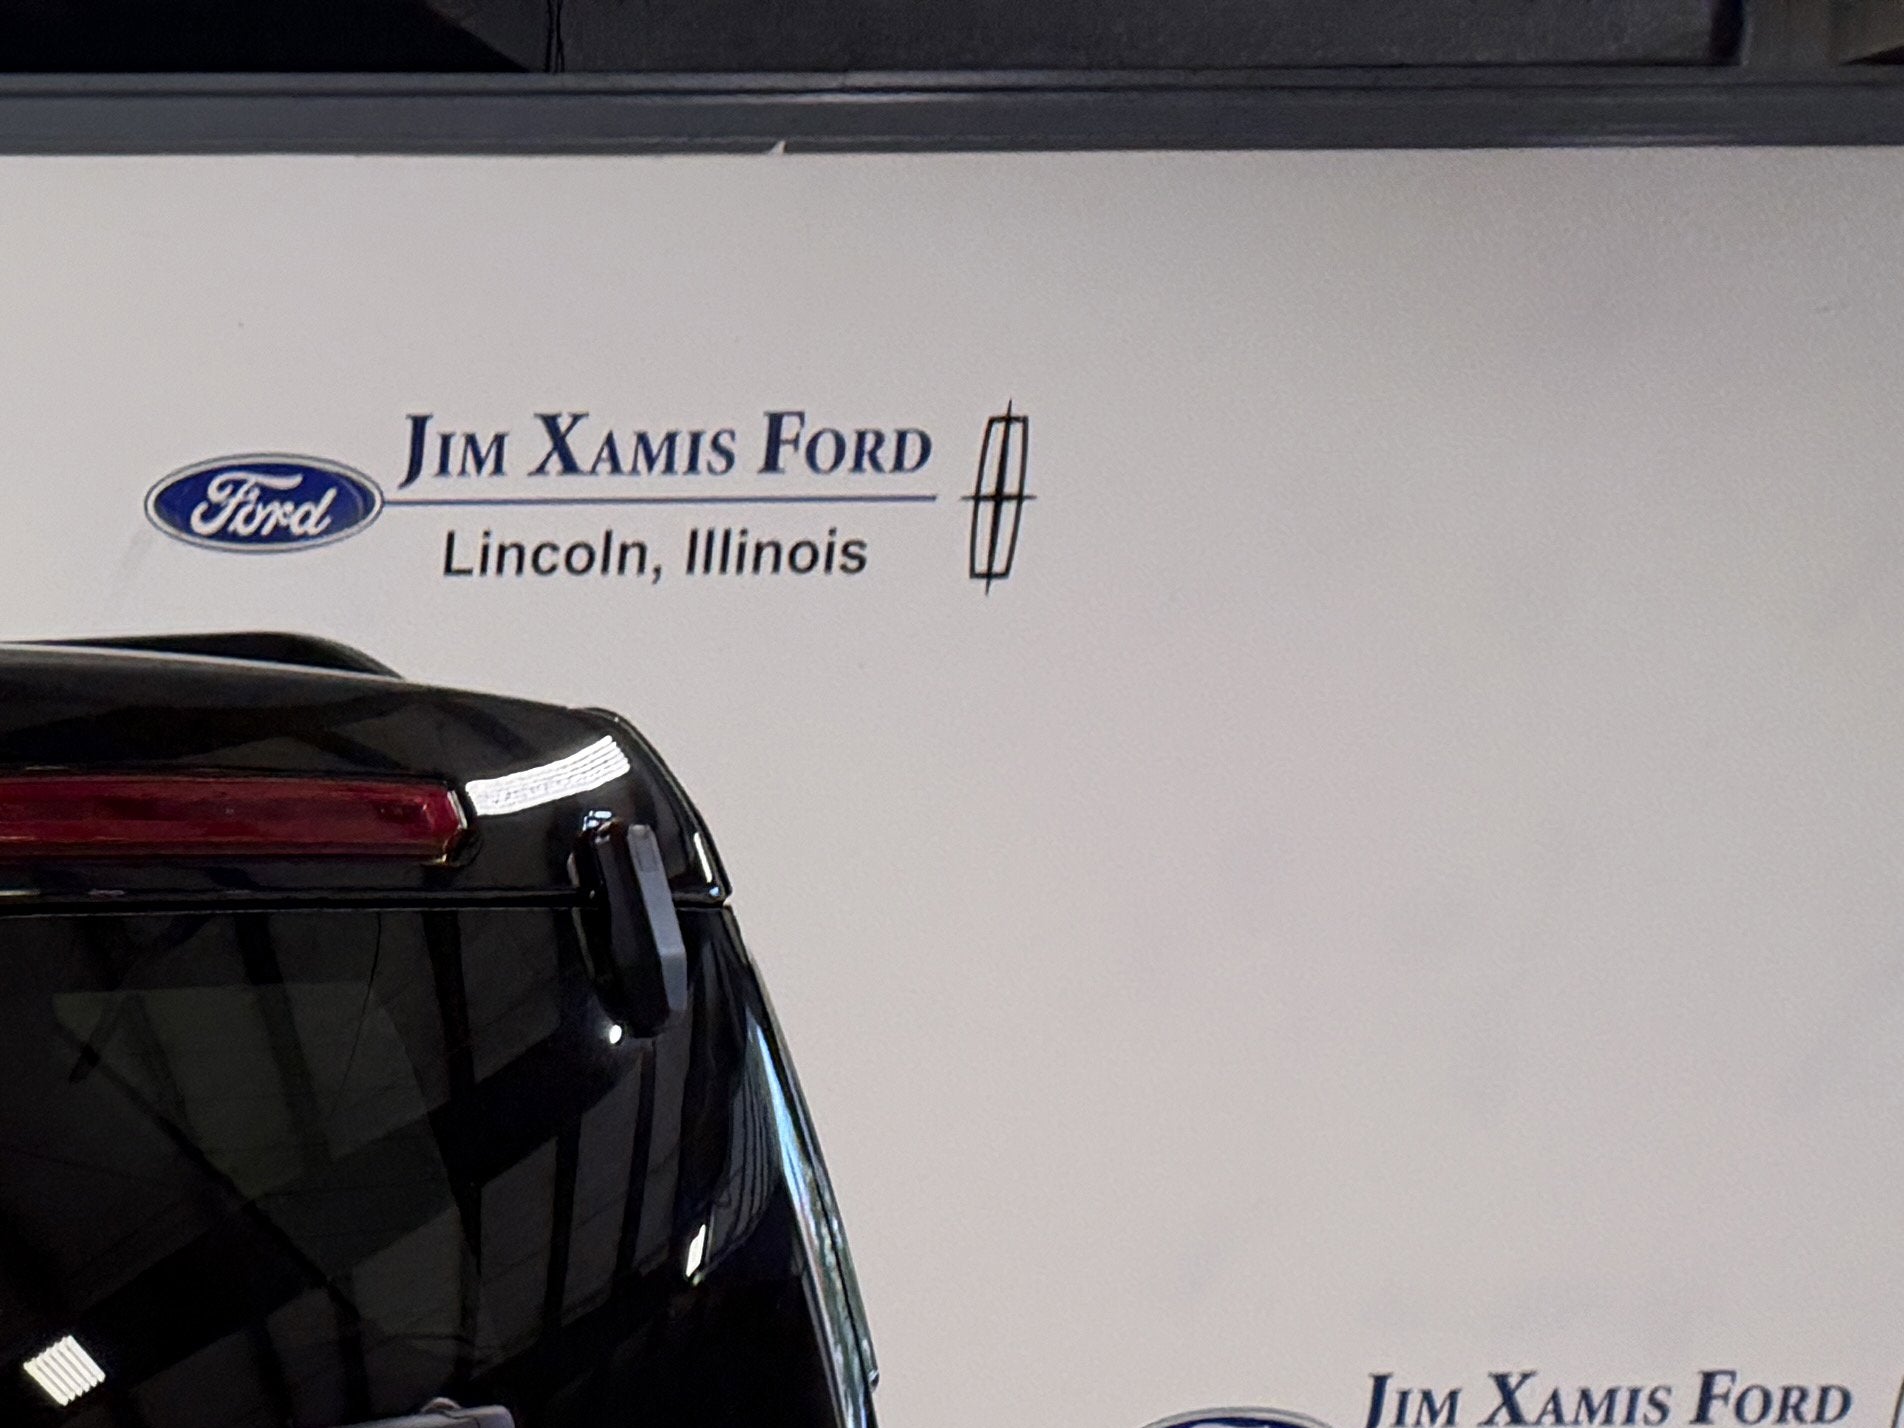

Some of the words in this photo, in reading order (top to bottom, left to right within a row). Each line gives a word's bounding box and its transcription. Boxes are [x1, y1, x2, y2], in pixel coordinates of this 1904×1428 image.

[397, 413, 509, 489] JIM
[527, 411, 736, 478] XAMIS
[758, 410, 932, 475] FORD
[190, 472, 331, 539] Ford
[442, 529, 664, 583] Lincoln,
[685, 526, 868, 575] Illinois
[1477, 1371, 1672, 1428] XAMIS
[1689, 1369, 1853, 1427] FORD
